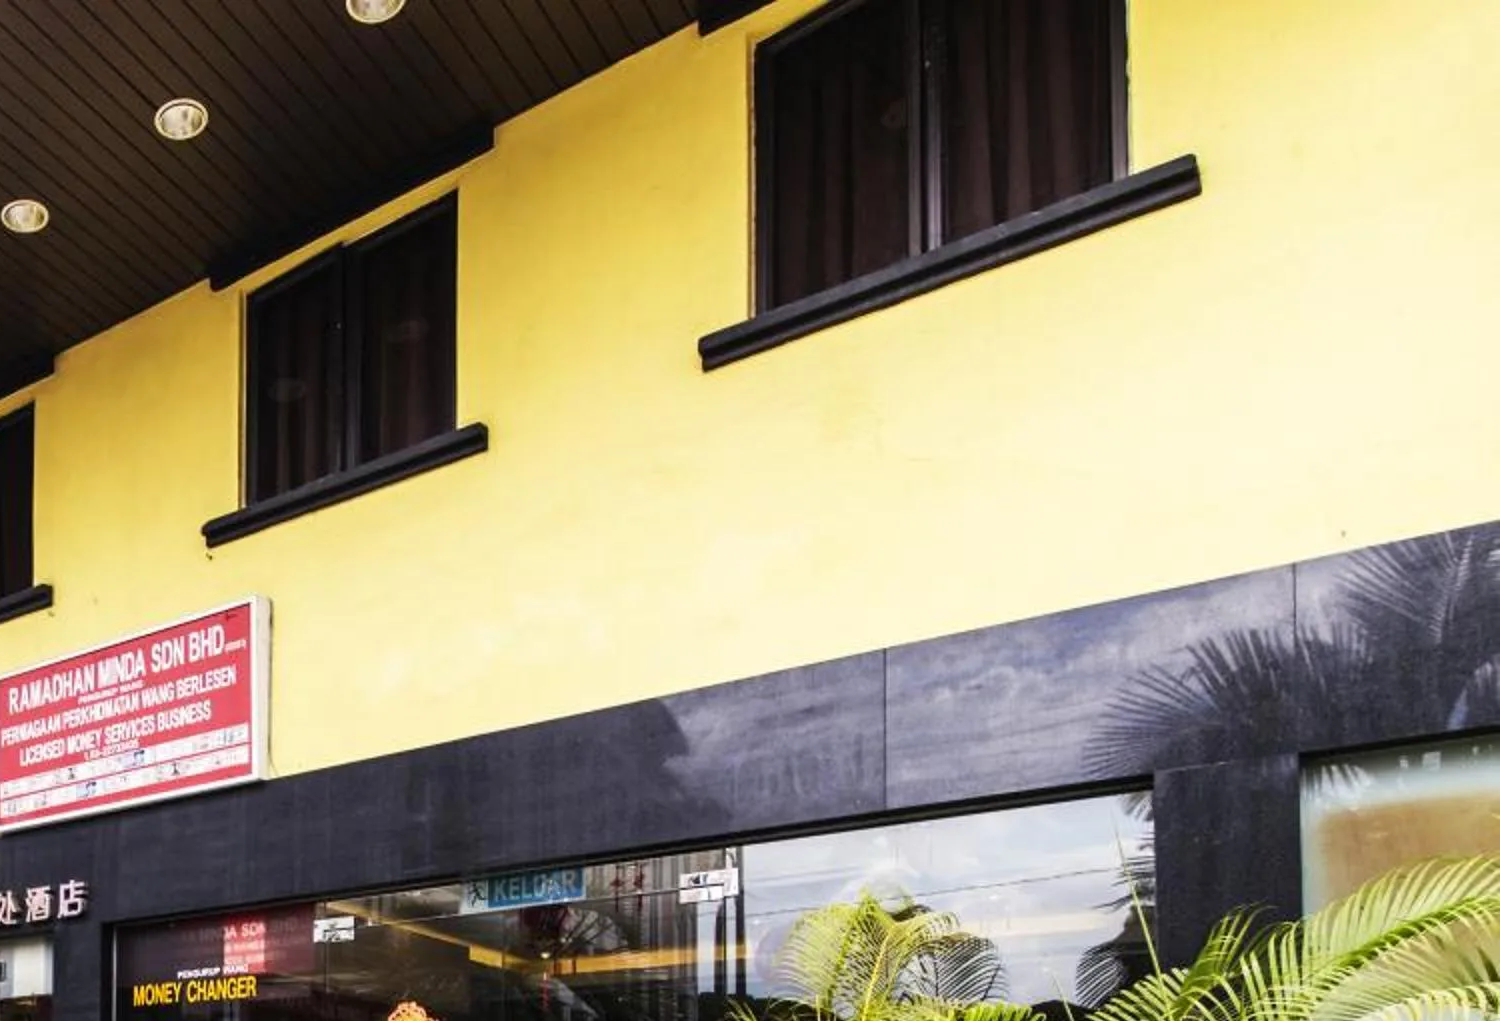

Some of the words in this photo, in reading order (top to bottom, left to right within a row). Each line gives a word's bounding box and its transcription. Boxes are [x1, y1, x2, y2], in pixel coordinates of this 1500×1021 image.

[8, 663, 96, 716] RAMADHAN
[97, 647, 147, 689] MINDA
[150, 635, 185, 673] SDN
[187, 624, 225, 663] BHD
[141, 681, 175, 709] WANG
[175, 664, 237, 700] BERLESEN
[19, 736, 65, 768] LICENSED
[66, 727, 102, 755] MONEY
[103, 713, 156, 747] SERVICES
[156, 698, 212, 733] BUSINESS
[493, 870, 578, 901] KELUAR
[132, 979, 183, 1008] MONEY
[186, 975, 258, 1004] CHANGER
